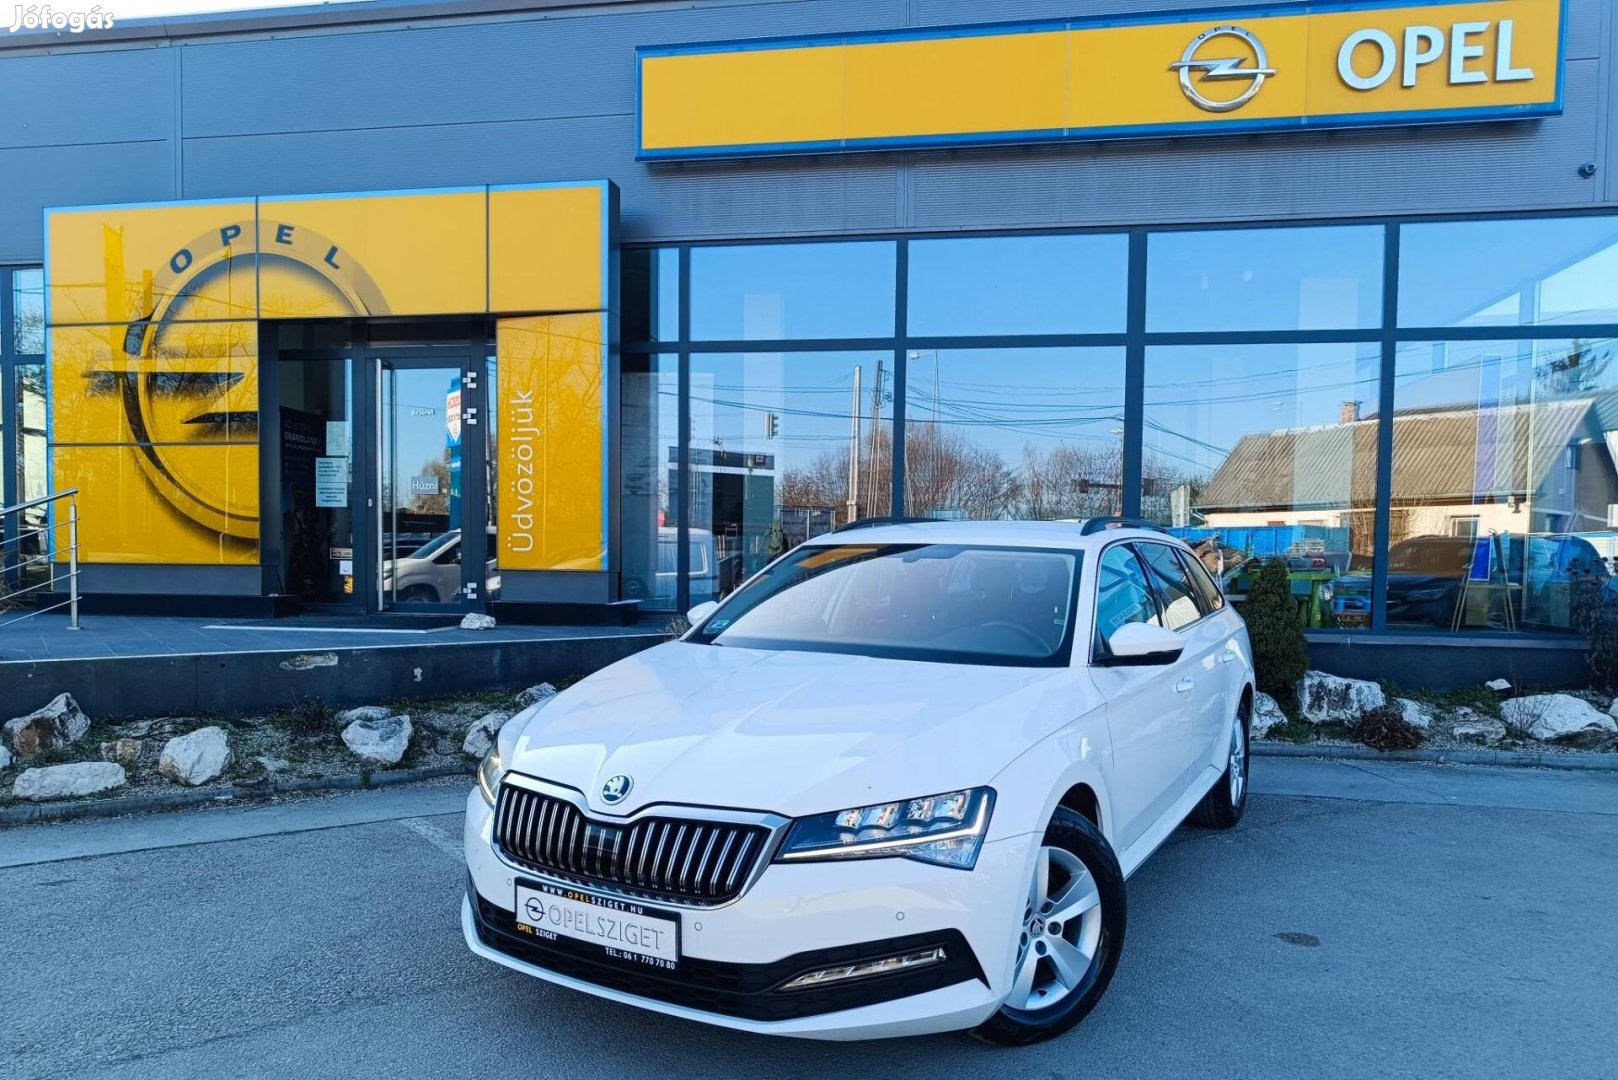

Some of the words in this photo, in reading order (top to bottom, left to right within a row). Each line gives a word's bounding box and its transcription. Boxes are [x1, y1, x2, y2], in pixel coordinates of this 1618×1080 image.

[1198, 26, 1250, 40] OPEL
[1337, 19, 1535, 91] OPEL
[170, 224, 340, 274] OPEL
[507, 389, 540, 552] Üdvözöljük
[542, 885, 643, 914] WWW.OPELSZIGET.HU
[517, 923, 533, 934] OPEL
[535, 929, 557, 941] SZIGET
[549, 904, 664, 950] OPELSZIGET
[623, 951, 632, 961] 06
[655, 959, 665, 968] 70
